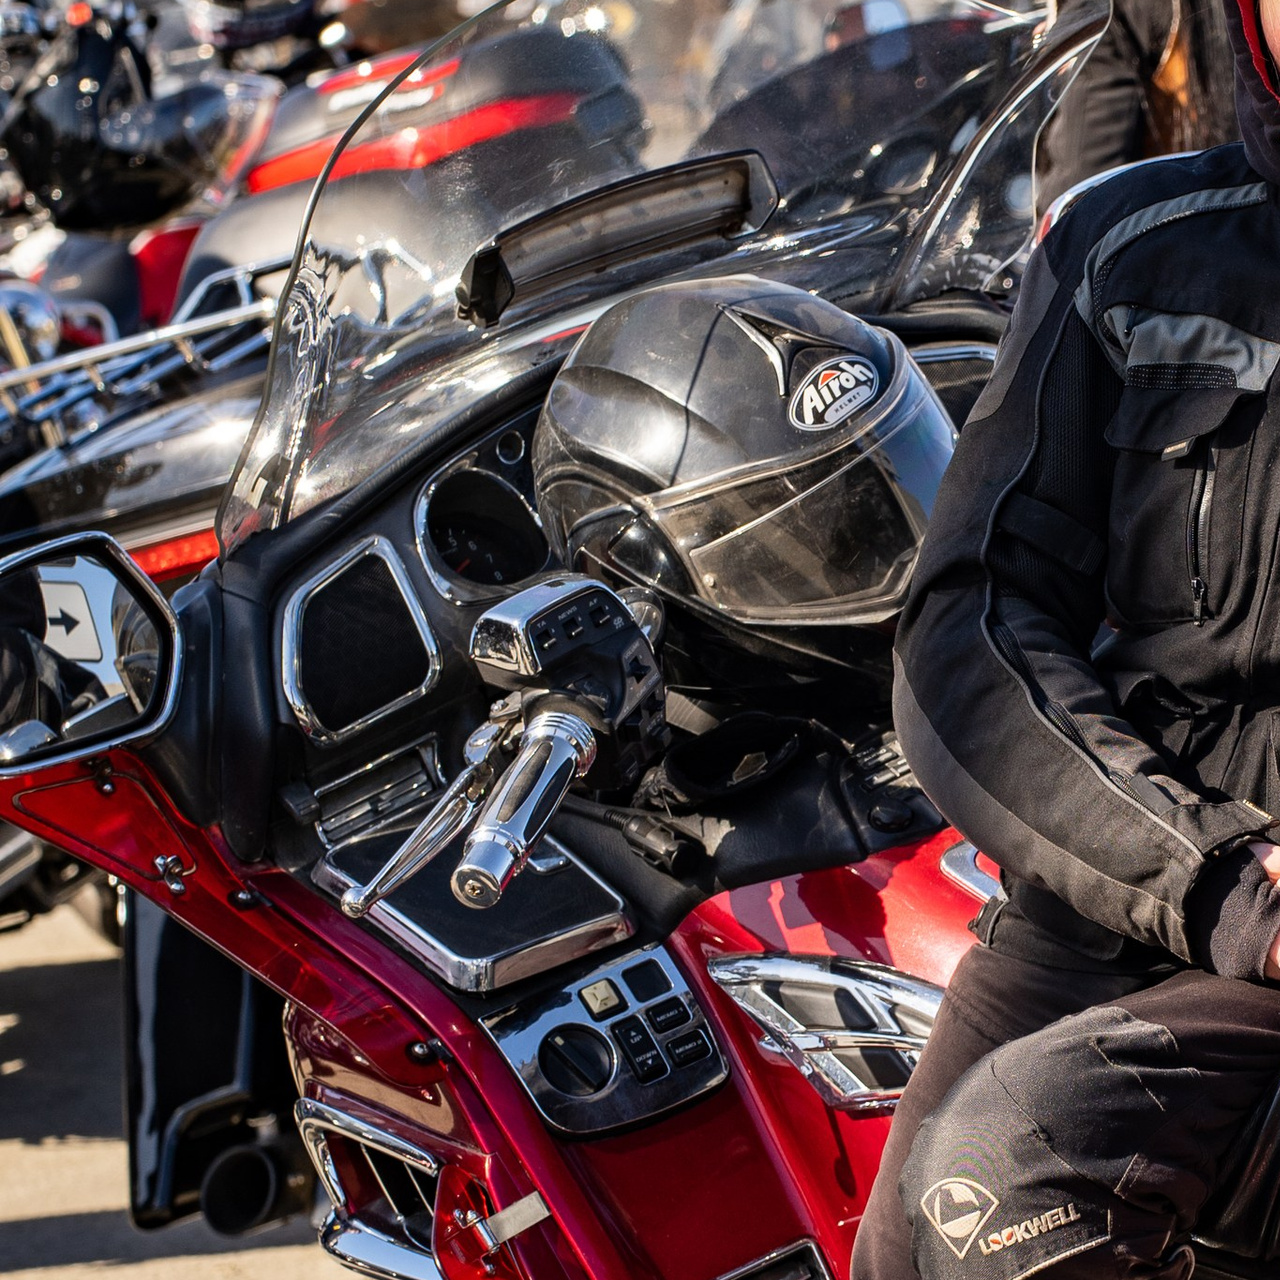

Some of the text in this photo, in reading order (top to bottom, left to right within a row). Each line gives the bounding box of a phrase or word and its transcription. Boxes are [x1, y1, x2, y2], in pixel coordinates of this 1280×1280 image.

[803, 361, 875, 425] Airoh
[834, 391, 861, 414] HELMET
[448, 536, 503, 581] 5 6 7 8
[558, 605, 578, 620] NEWS
[656, 1009, 678, 1022] MEMO
[630, 1034, 642, 1044] UP
[675, 1041, 697, 1054] MEMO
[635, 1049, 657, 1063] DOWN
[978, 1202, 1081, 1256] LOOKWELL
